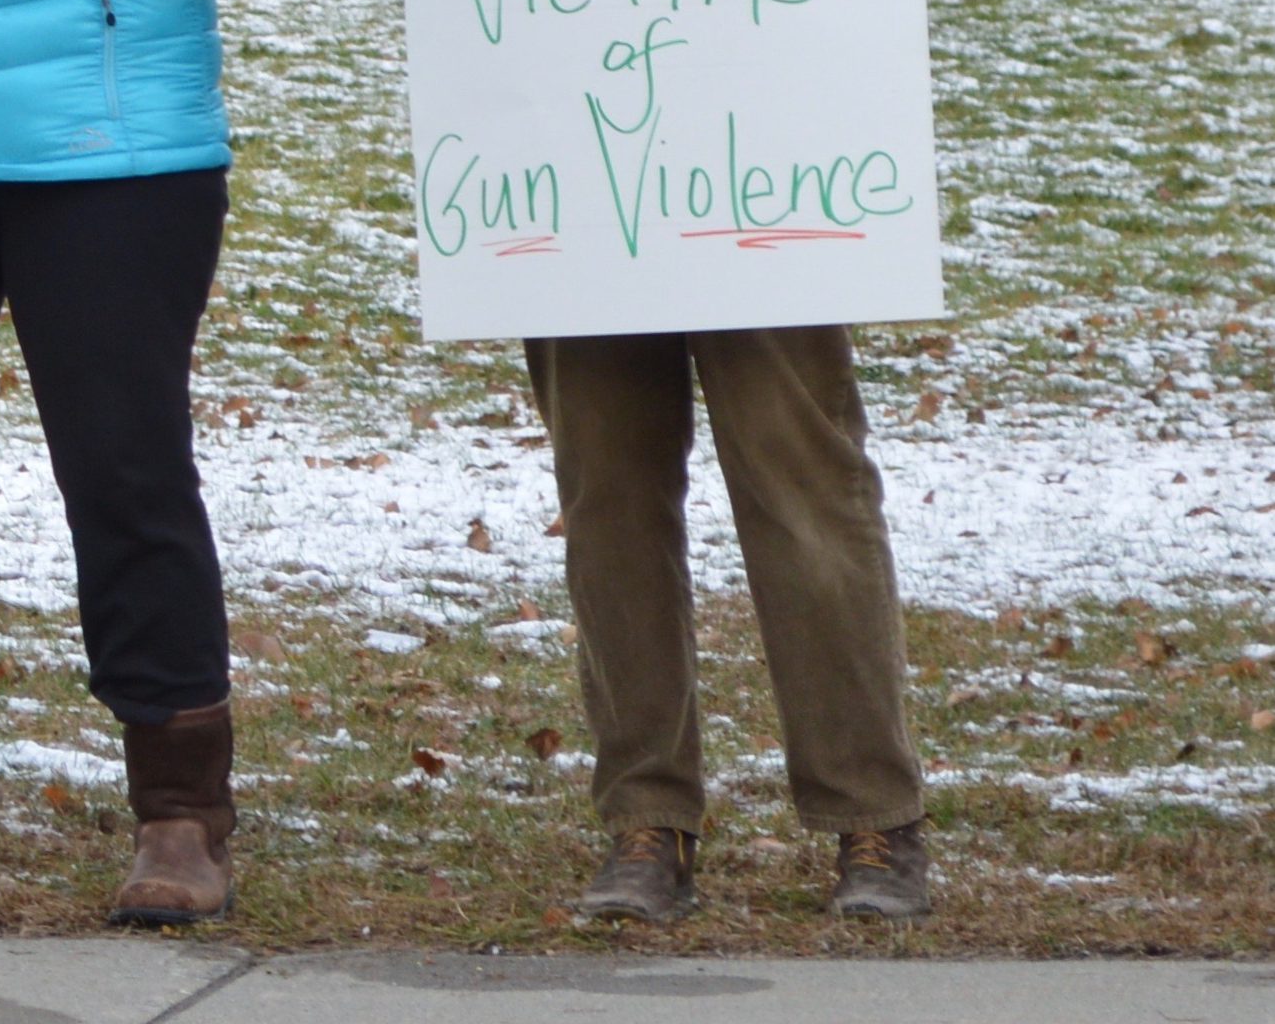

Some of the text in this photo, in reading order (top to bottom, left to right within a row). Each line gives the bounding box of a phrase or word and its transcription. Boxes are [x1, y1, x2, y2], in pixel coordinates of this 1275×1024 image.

[597, 18, 689, 133] of
[422, 92, 913, 258] Gun Violence
